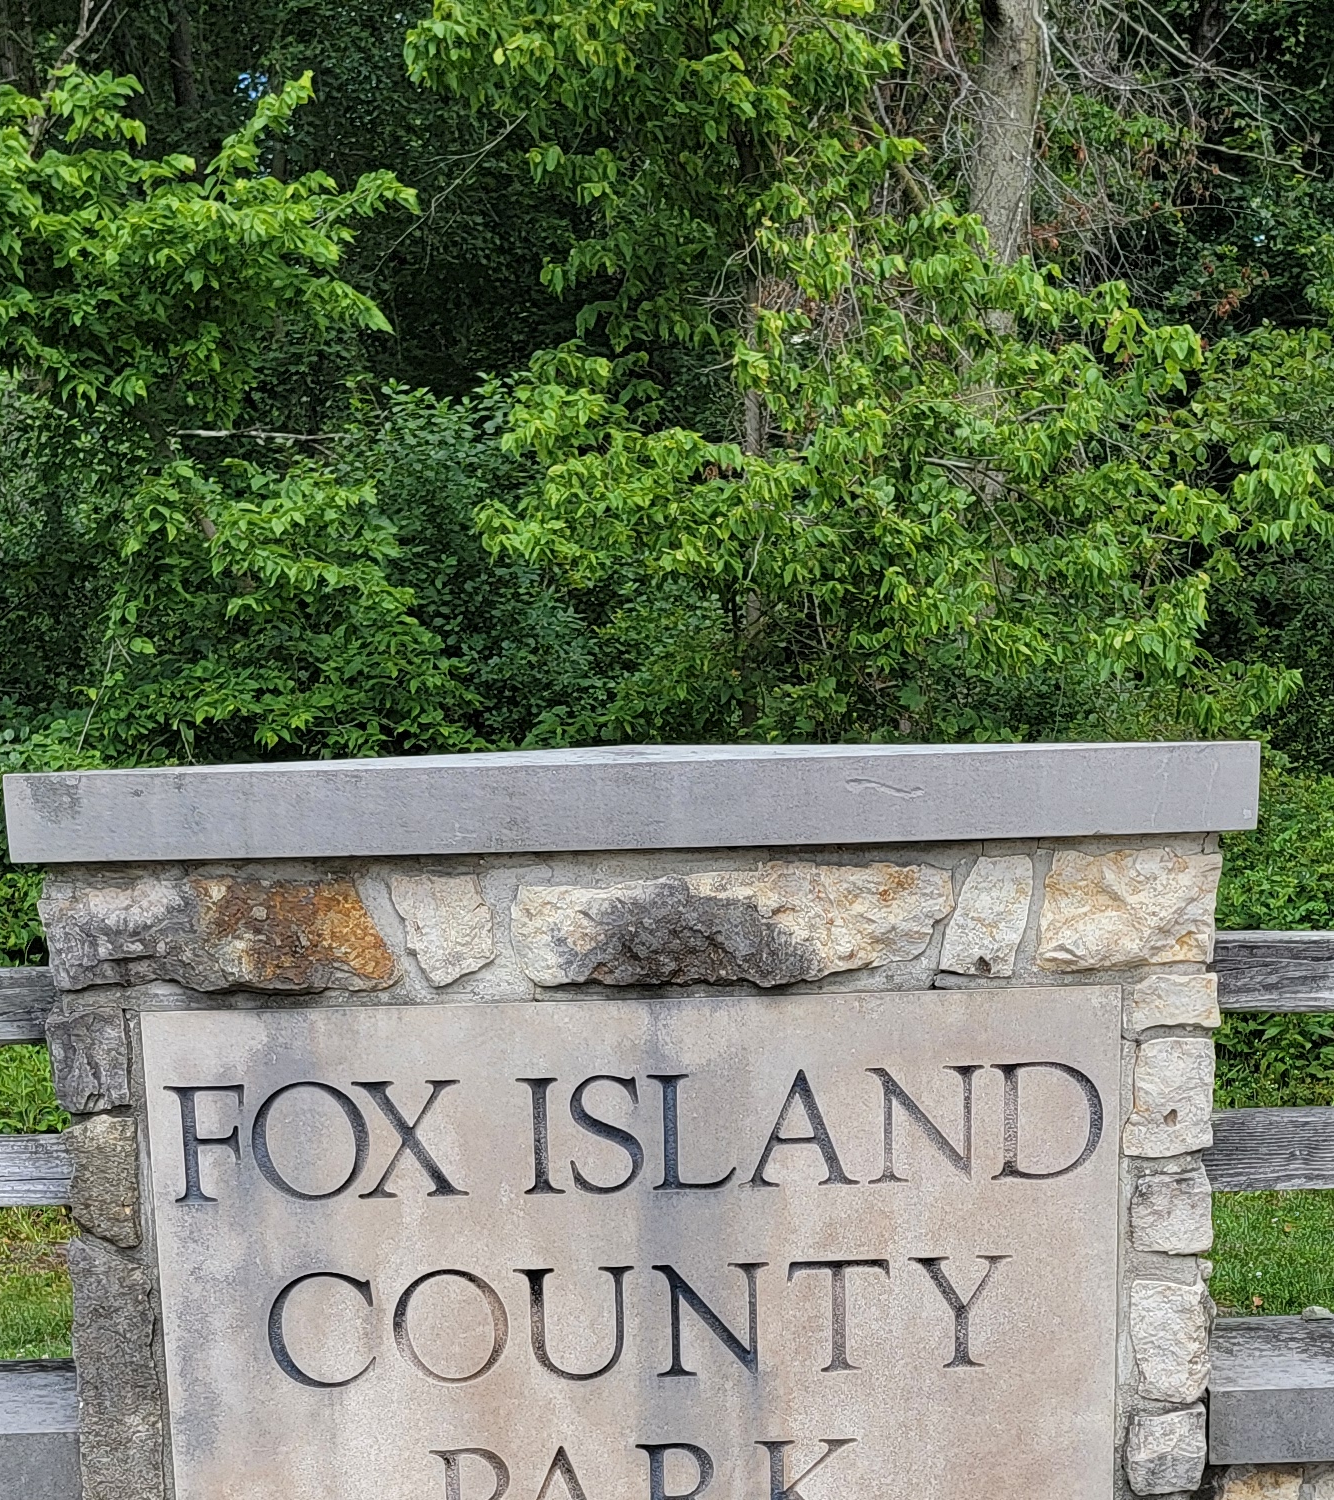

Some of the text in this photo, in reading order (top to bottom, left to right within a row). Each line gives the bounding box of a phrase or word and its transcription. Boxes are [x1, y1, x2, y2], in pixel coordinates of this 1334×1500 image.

[162, 1061, 1103, 1204] FOX ISLAND
[267, 1253, 1013, 1389] COUNTY
